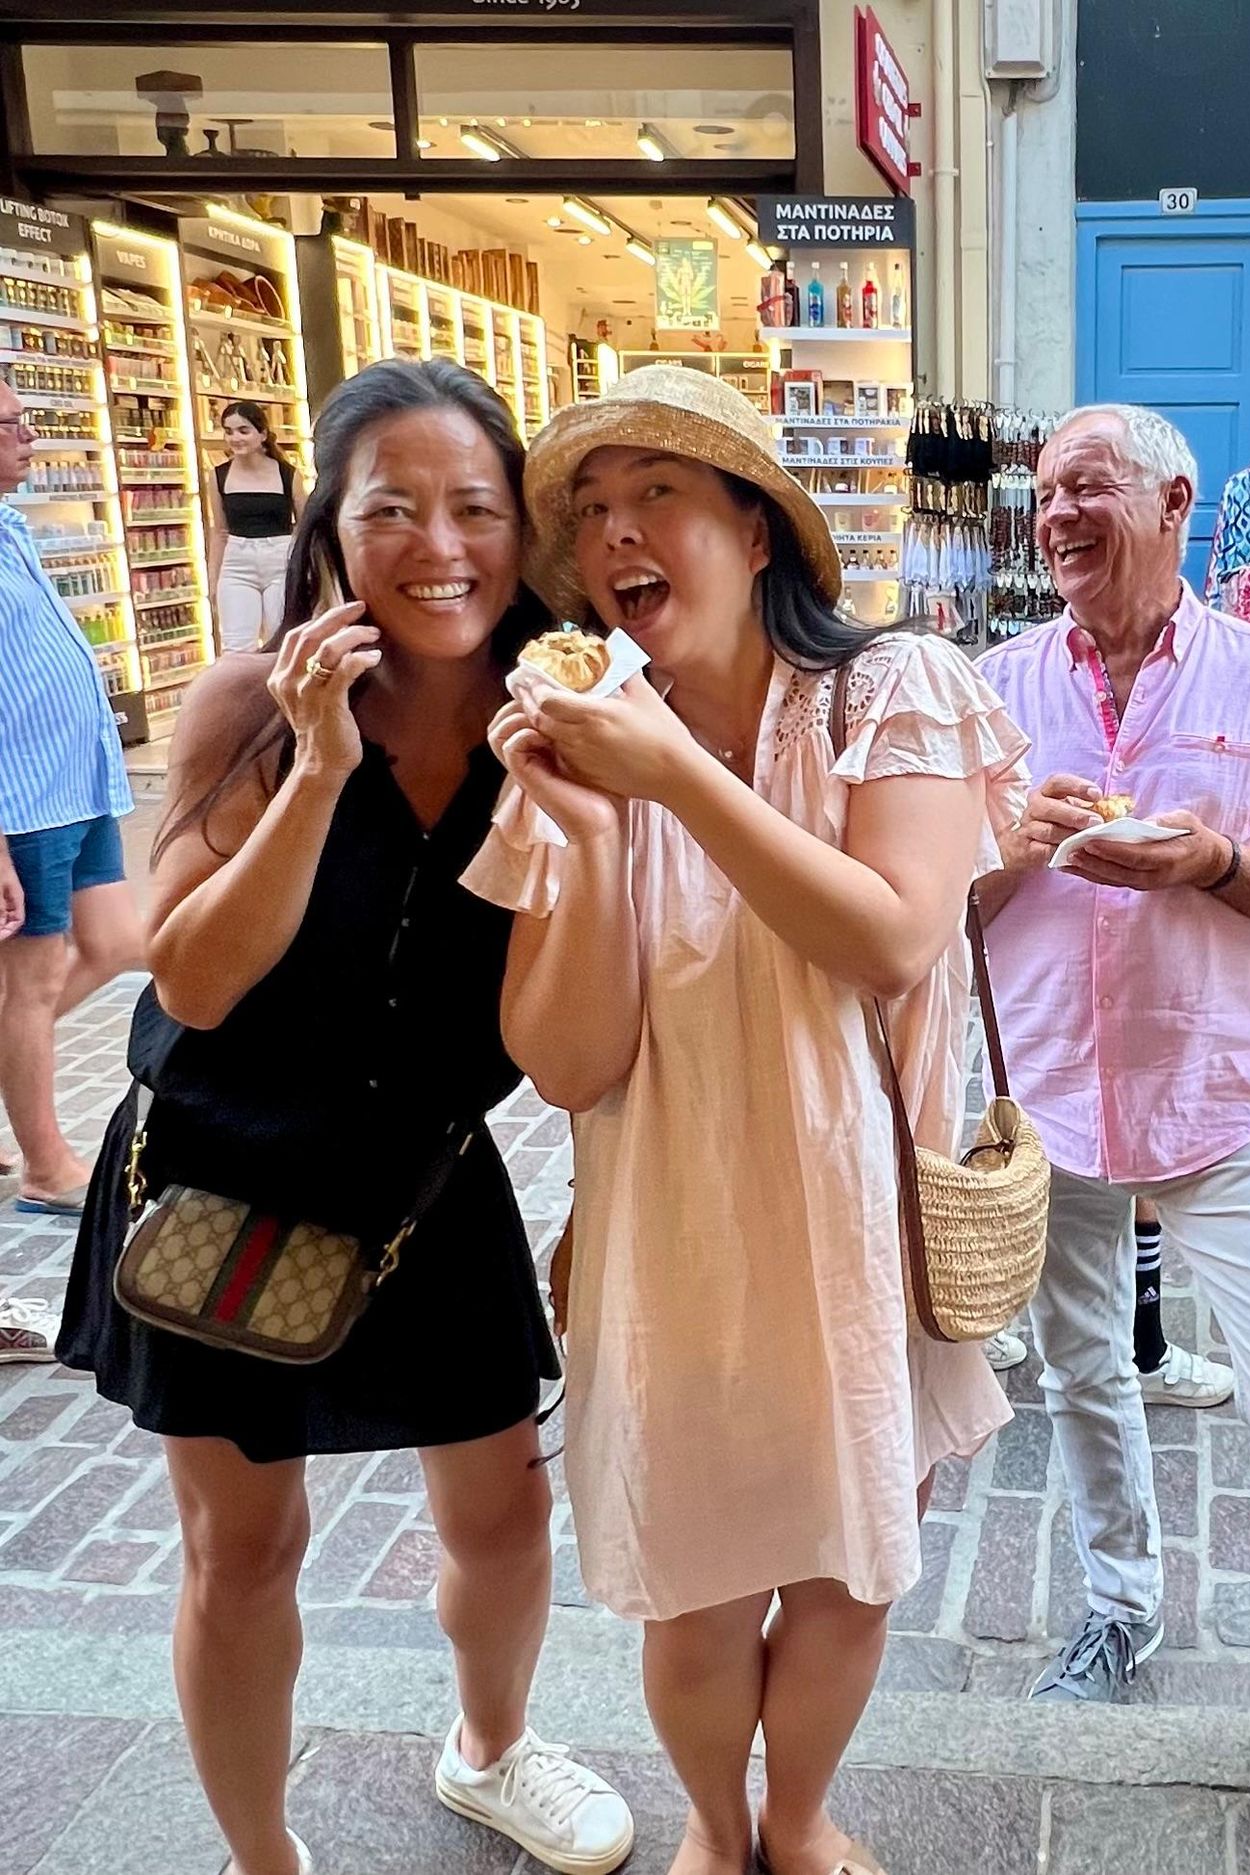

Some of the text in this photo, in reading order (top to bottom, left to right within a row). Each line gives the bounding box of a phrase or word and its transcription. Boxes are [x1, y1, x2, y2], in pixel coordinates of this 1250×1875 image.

[1167, 193, 1189, 210] 30
[0, 198, 70, 228] LIFTING BOTOX
[775, 203, 895, 220] ΜΑΝΤΙΝΑΔΕΣ
[17, 222, 52, 243] EFFECT
[776, 224, 894, 241] ΣΤΑ ΠΟΤΗΡΙΑ
[116, 250, 147, 269] VAPES
